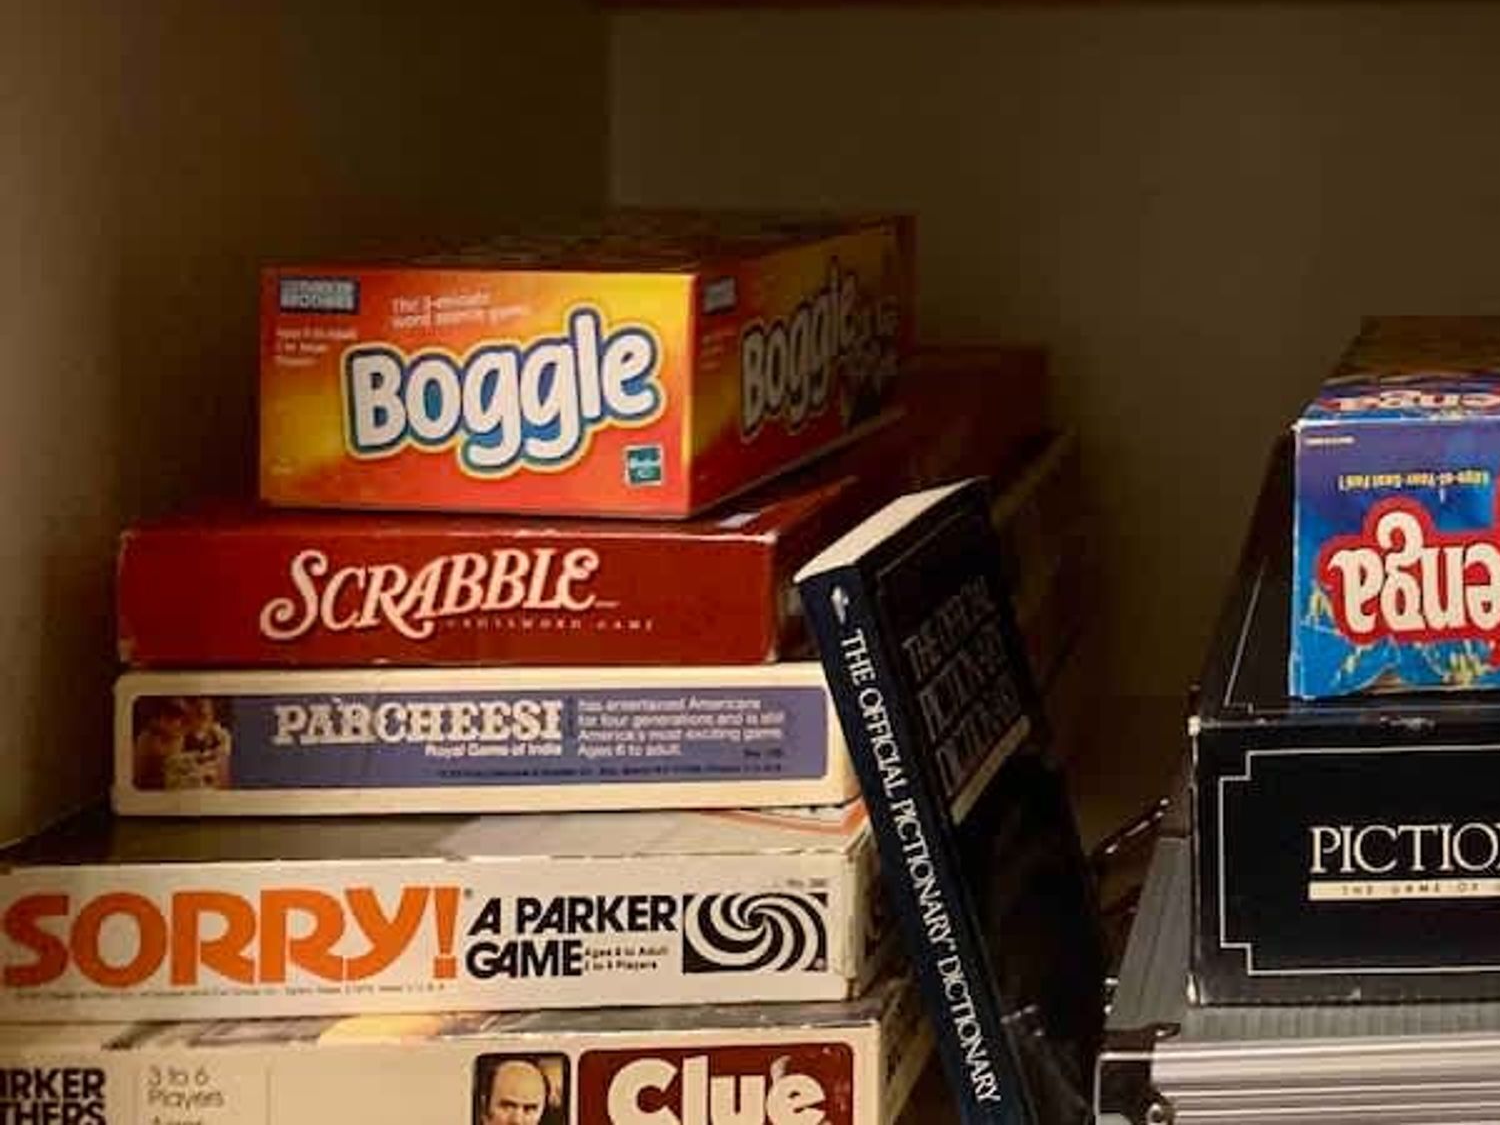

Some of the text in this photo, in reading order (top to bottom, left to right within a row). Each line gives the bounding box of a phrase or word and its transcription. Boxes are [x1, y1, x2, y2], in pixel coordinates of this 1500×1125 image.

[344, 307, 662, 479] Boggle
[258, 546, 600, 640] SCRABBLE
[271, 698, 564, 745] PARCHEESI
[717, 712, 744, 725] and
[577, 742, 614, 761] Ages
[628, 743, 644, 757] to
[840, 628, 1002, 1106] THE OFFICIAL PICTIONARY DICTIONARY
[0, 885, 463, 988] SORRY!
[466, 894, 679, 936] A PARKER
[464, 939, 584, 979] GAME
[147, 1065, 209, 1087] 3 to 6
[607, 1055, 826, 1125] Clue
[147, 1087, 227, 1111] Players
